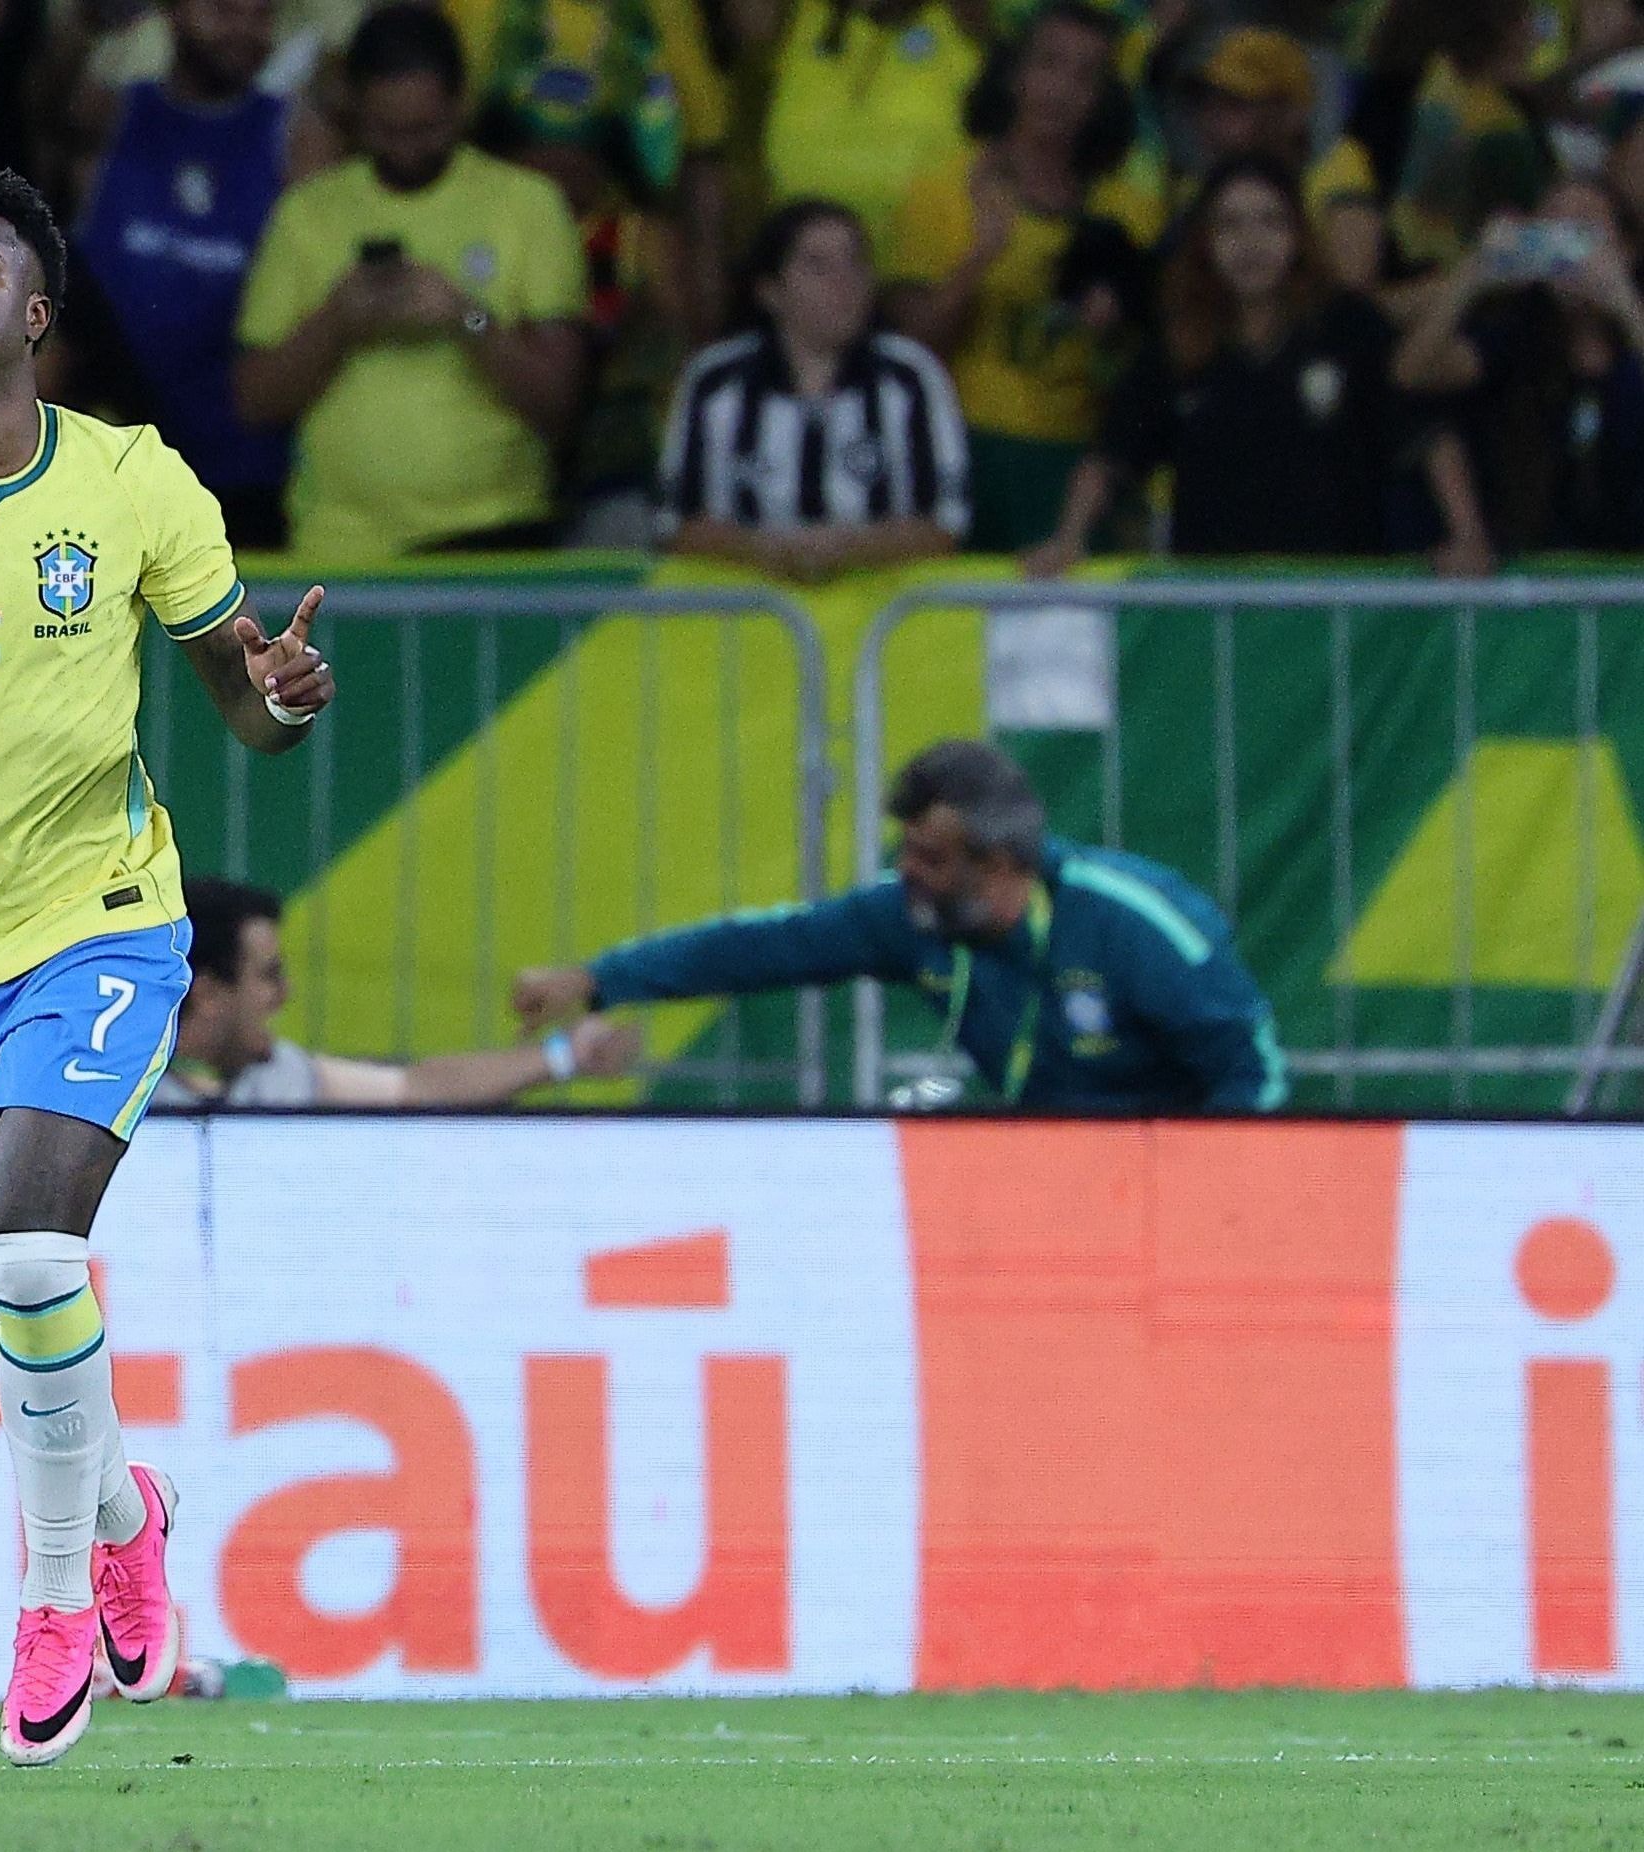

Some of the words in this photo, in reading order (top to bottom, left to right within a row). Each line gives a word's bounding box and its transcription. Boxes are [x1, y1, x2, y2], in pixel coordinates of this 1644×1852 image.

[55, 573, 77, 583] CBF
[34, 622, 92, 639] BRASIL
[89, 973, 138, 1055] 7
